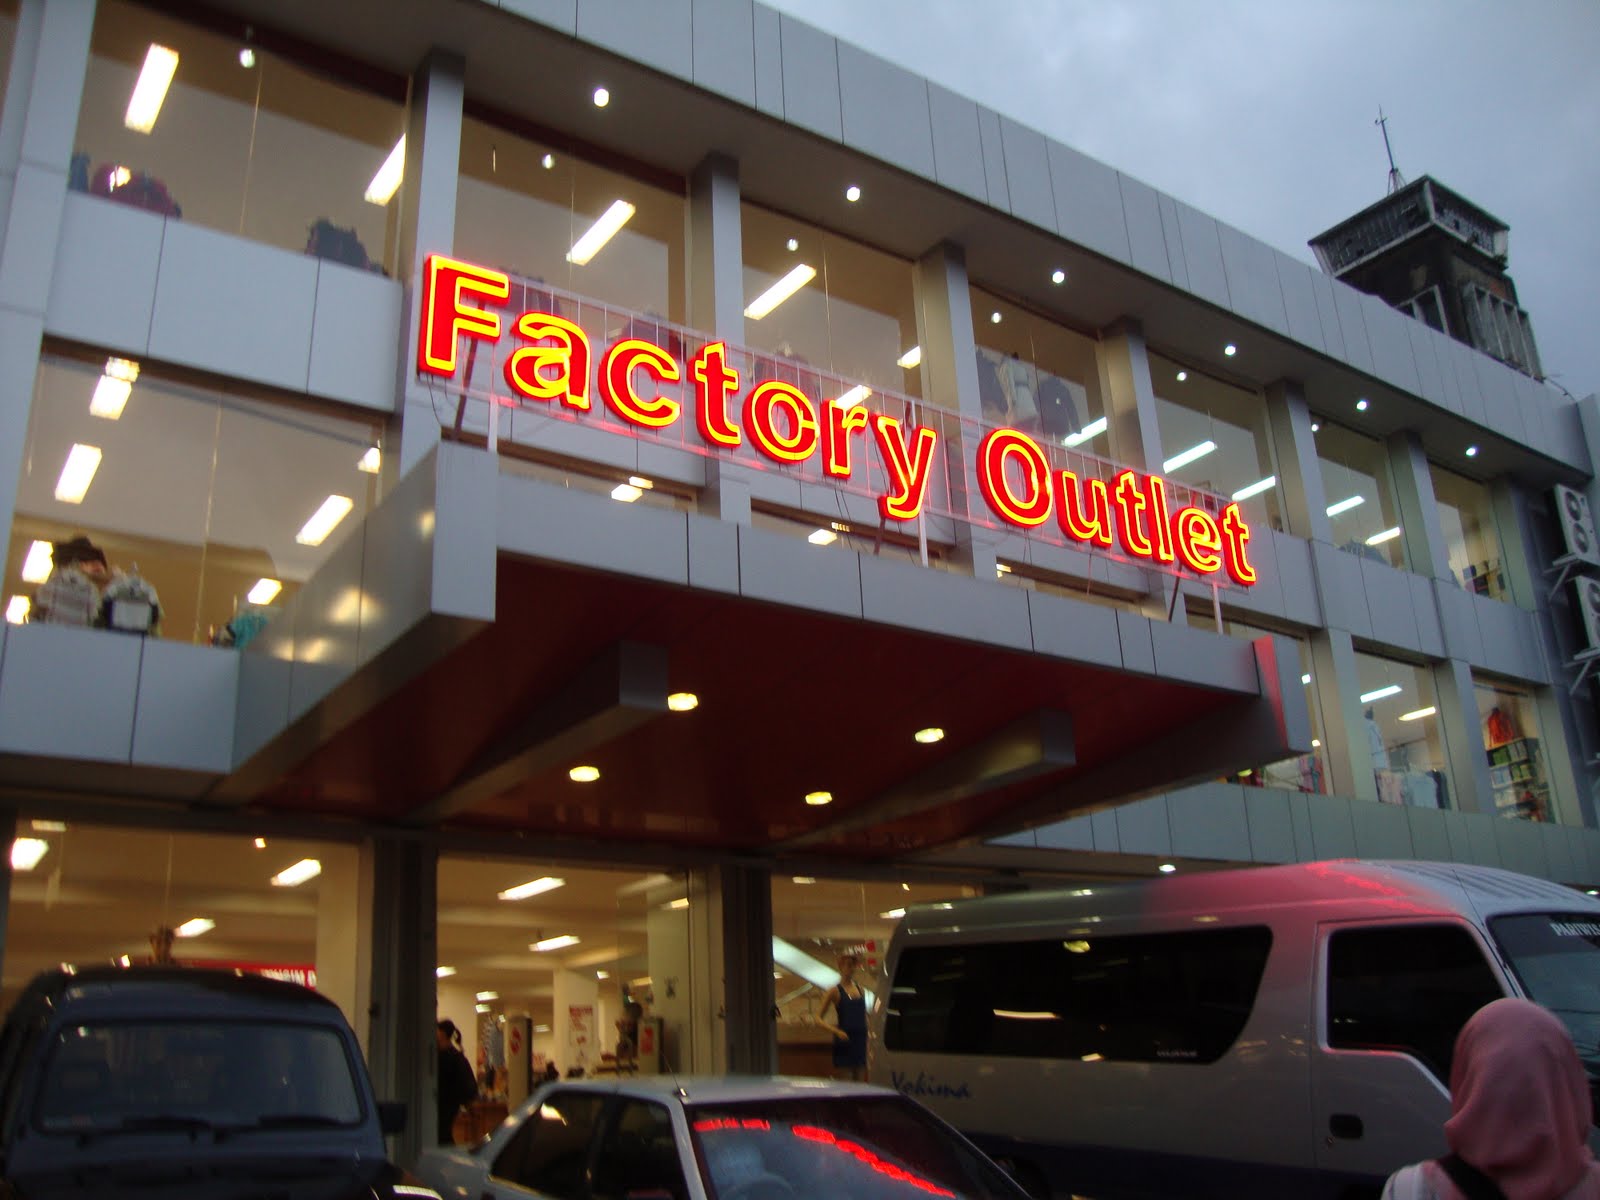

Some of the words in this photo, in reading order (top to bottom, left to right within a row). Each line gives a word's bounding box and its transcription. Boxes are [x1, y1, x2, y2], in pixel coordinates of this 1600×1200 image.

[418, 254, 938, 521] Factory
[977, 426, 1257, 585] Outlet
[1549, 922, 1600, 937] PARIWIS
